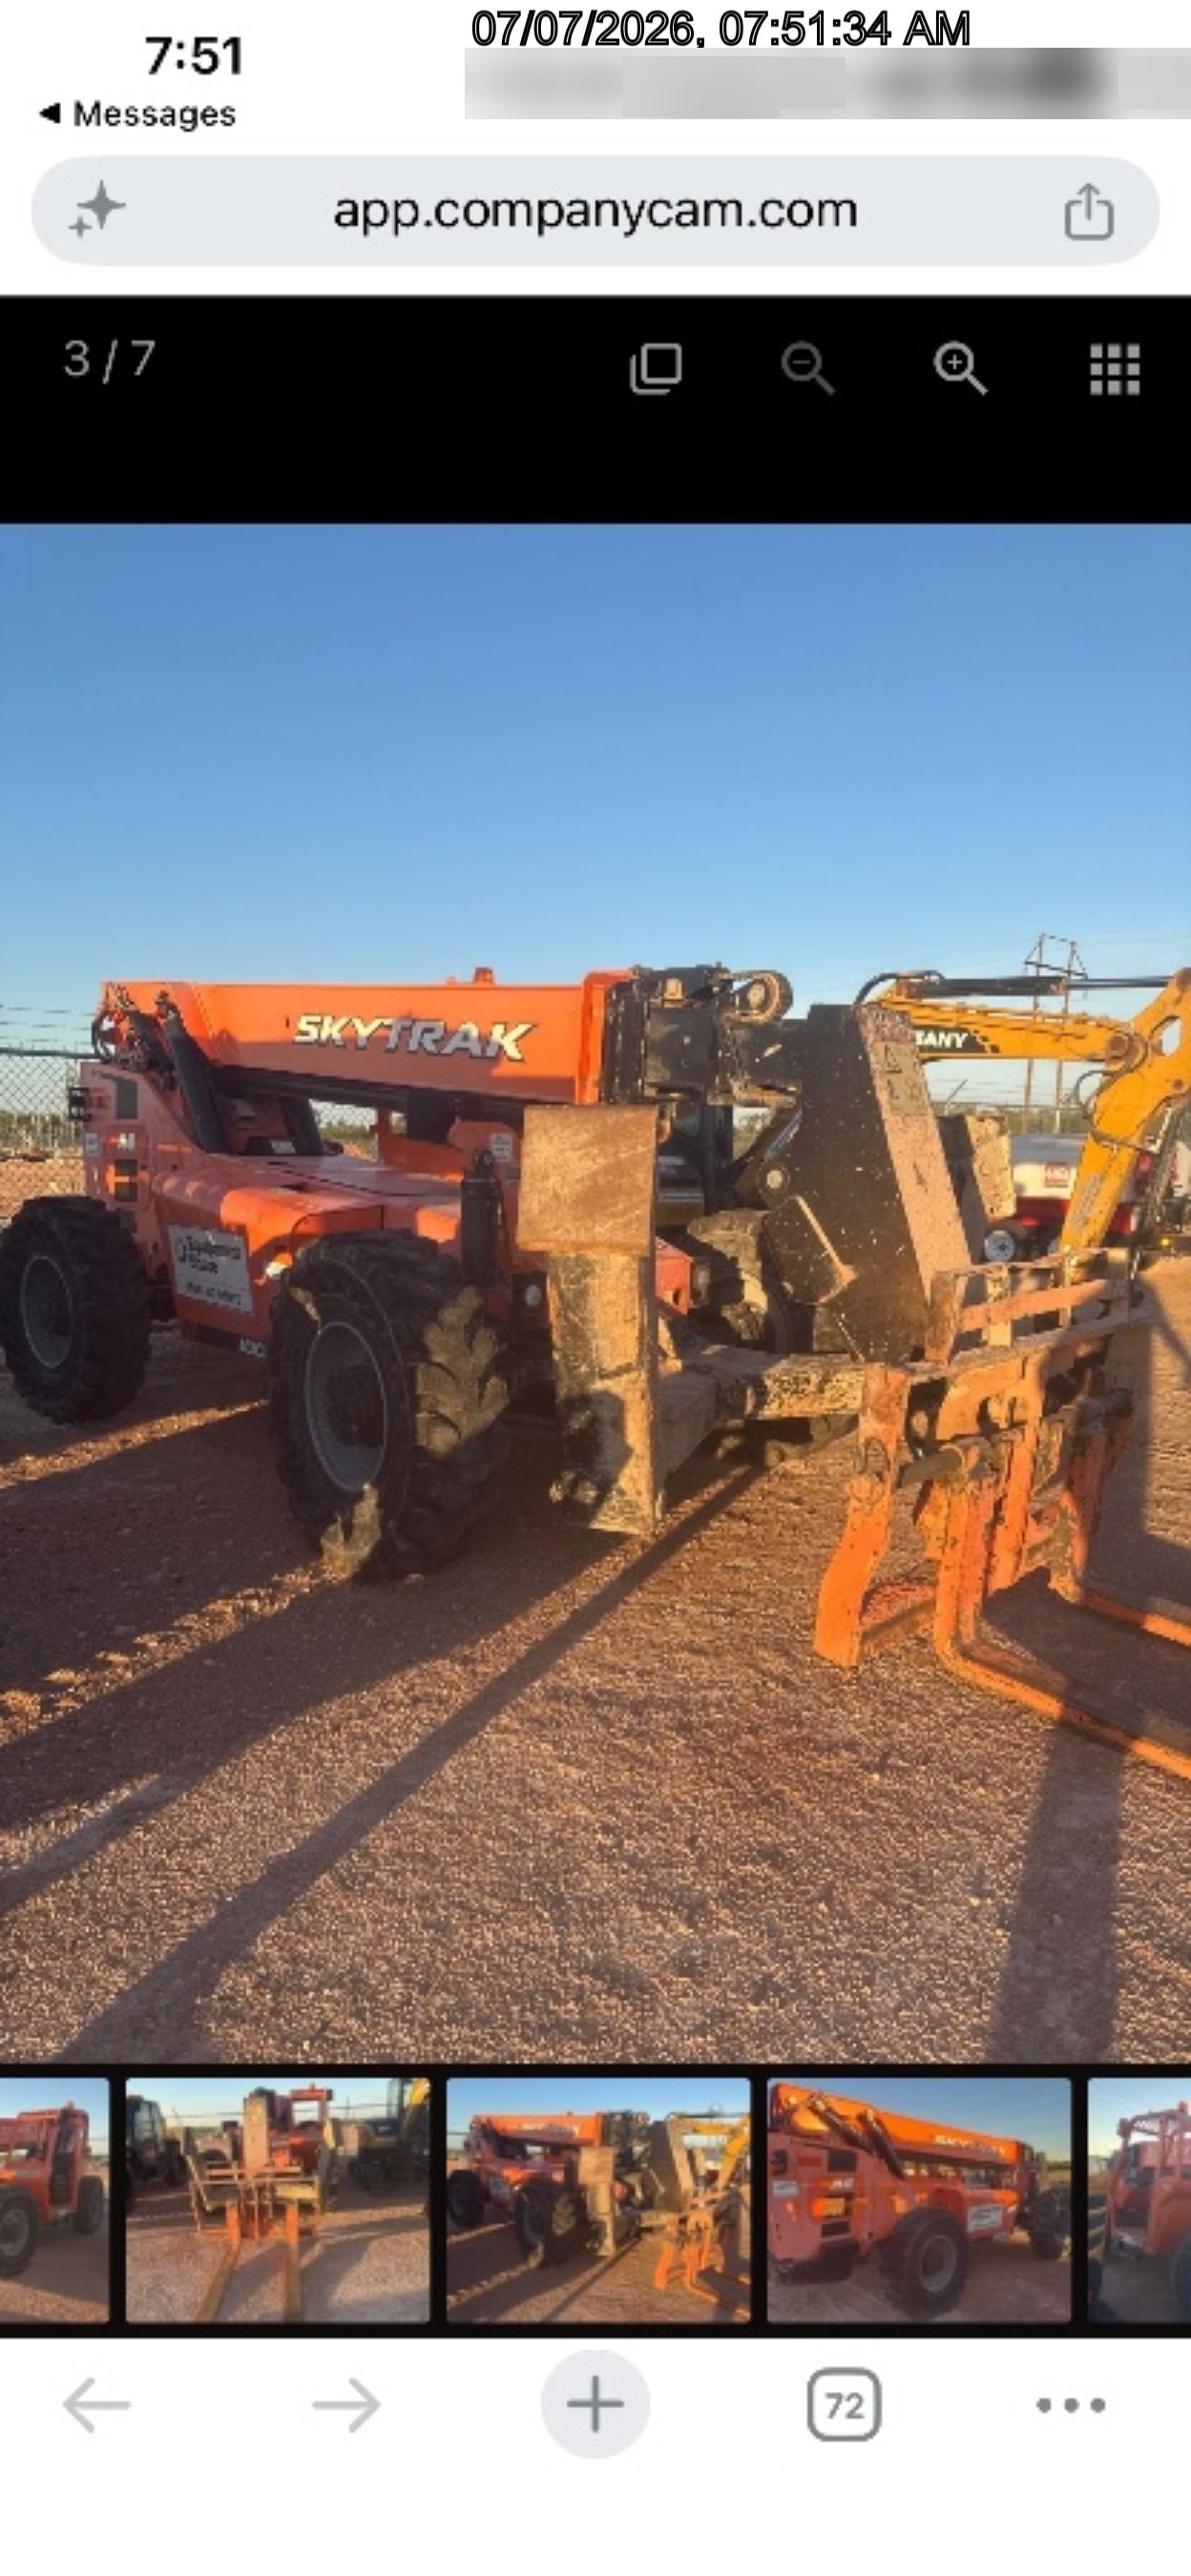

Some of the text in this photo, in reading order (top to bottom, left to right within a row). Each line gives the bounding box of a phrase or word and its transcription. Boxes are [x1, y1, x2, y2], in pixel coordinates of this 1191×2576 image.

[145, 36, 241, 76] 7:51
[73, 99, 236, 134] Messages
[333, 197, 858, 239] app.companycam.com
[64, 340, 91, 377] 3
[131, 340, 156, 376] 7
[293, 1014, 535, 1061] SKYTRAK
[824, 2391, 866, 2420] 72
